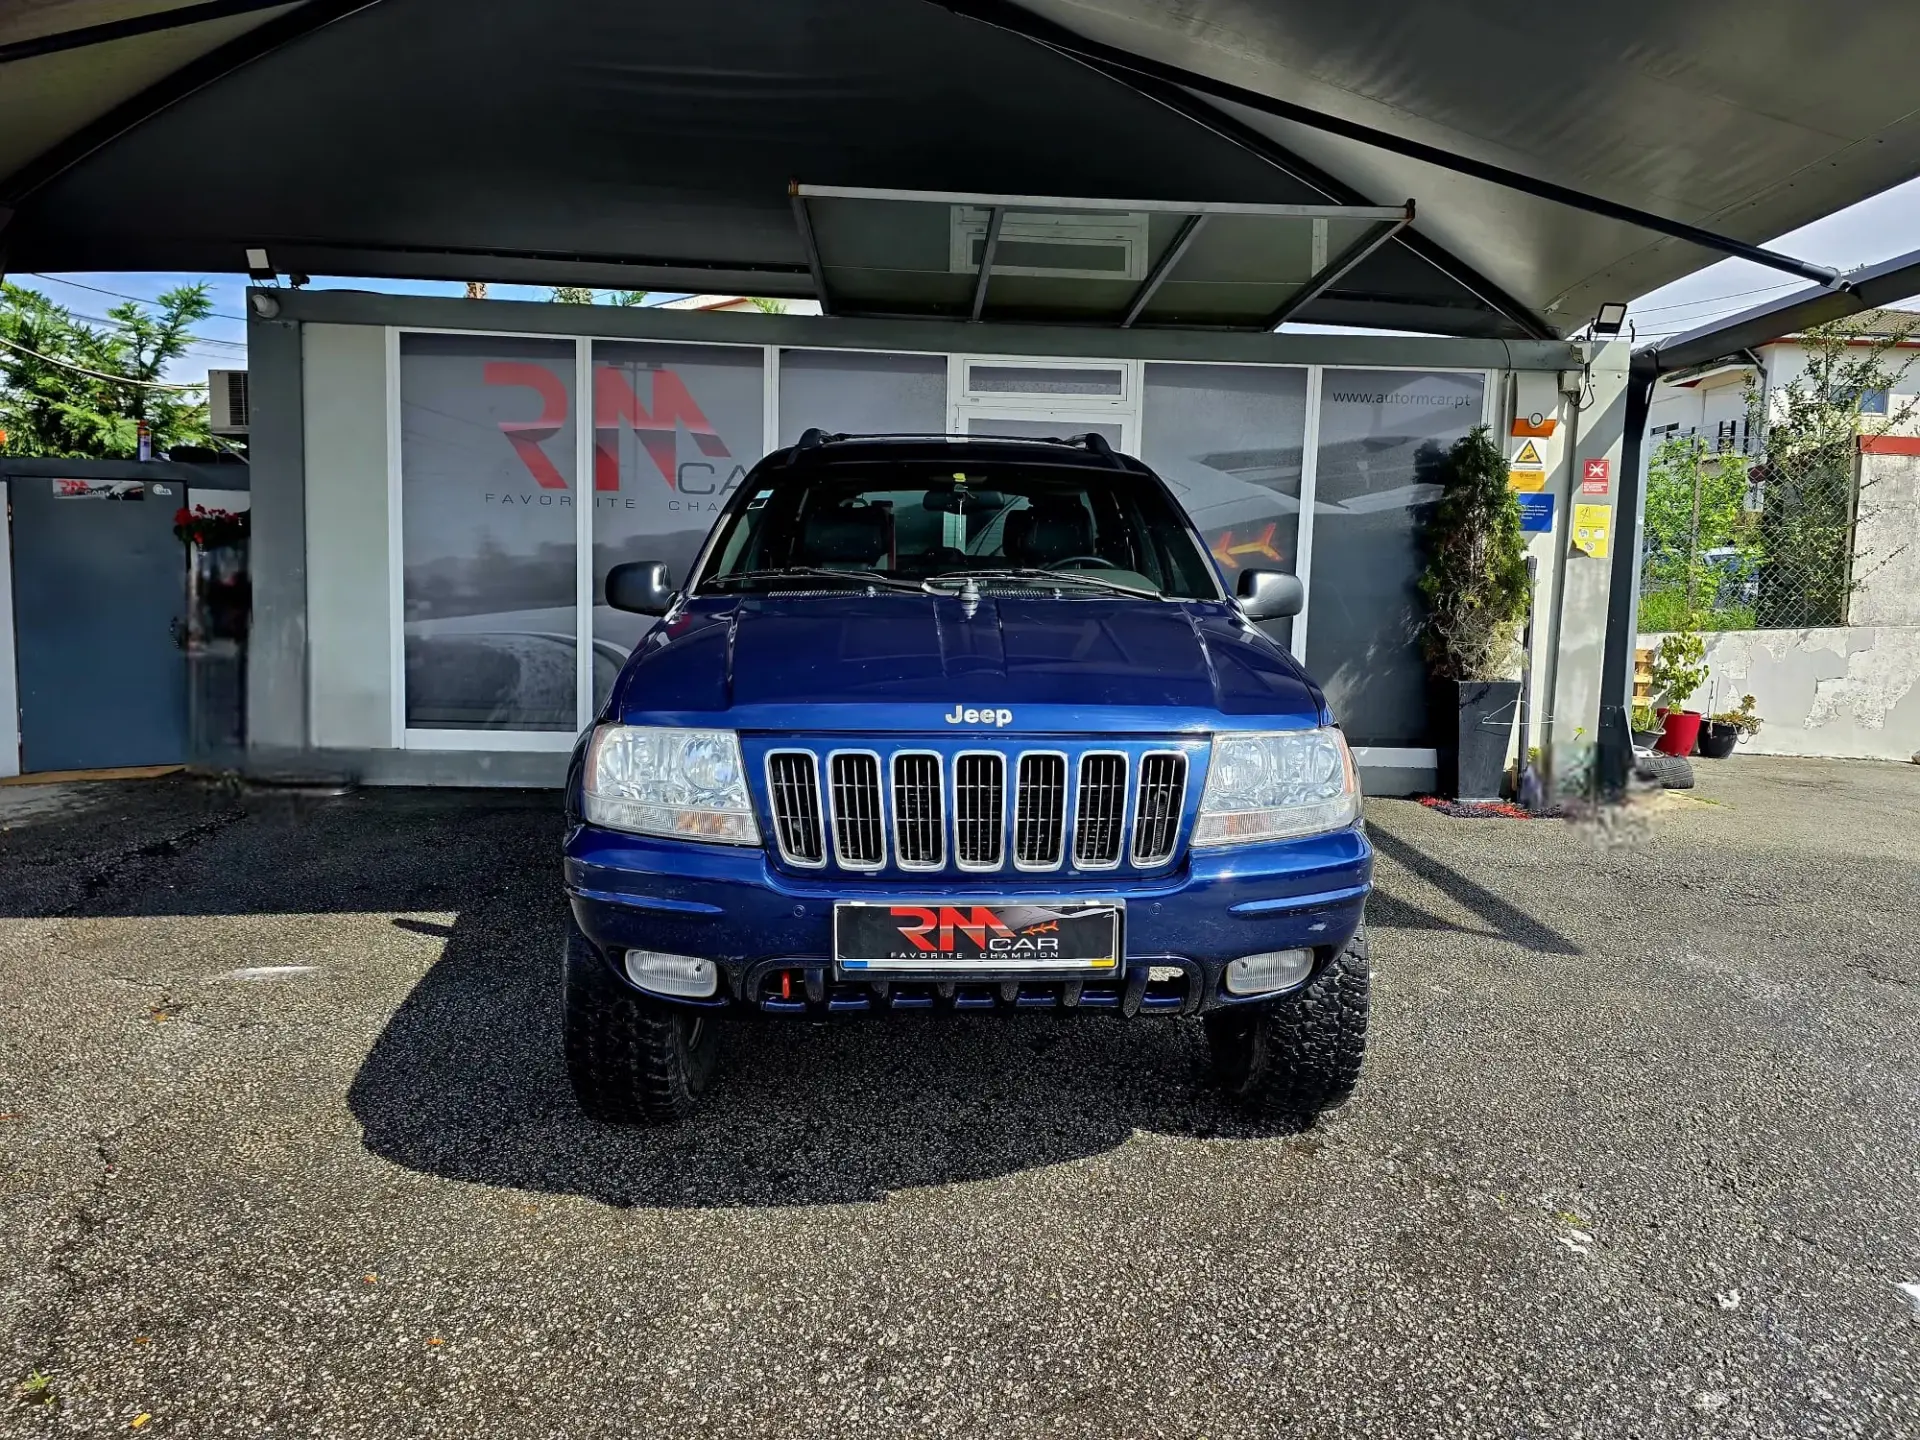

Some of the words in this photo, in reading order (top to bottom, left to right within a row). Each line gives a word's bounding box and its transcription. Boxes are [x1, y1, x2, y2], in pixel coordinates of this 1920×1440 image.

[1332, 392, 1471, 409] www.autormcar.pt
[484, 361, 732, 492] RM
[678, 462, 747, 496] CA
[945, 704, 1013, 728] Jeep
[890, 906, 1017, 952] RM
[979, 951, 1059, 959] CHAMPION
[989, 937, 1059, 951] CAR
